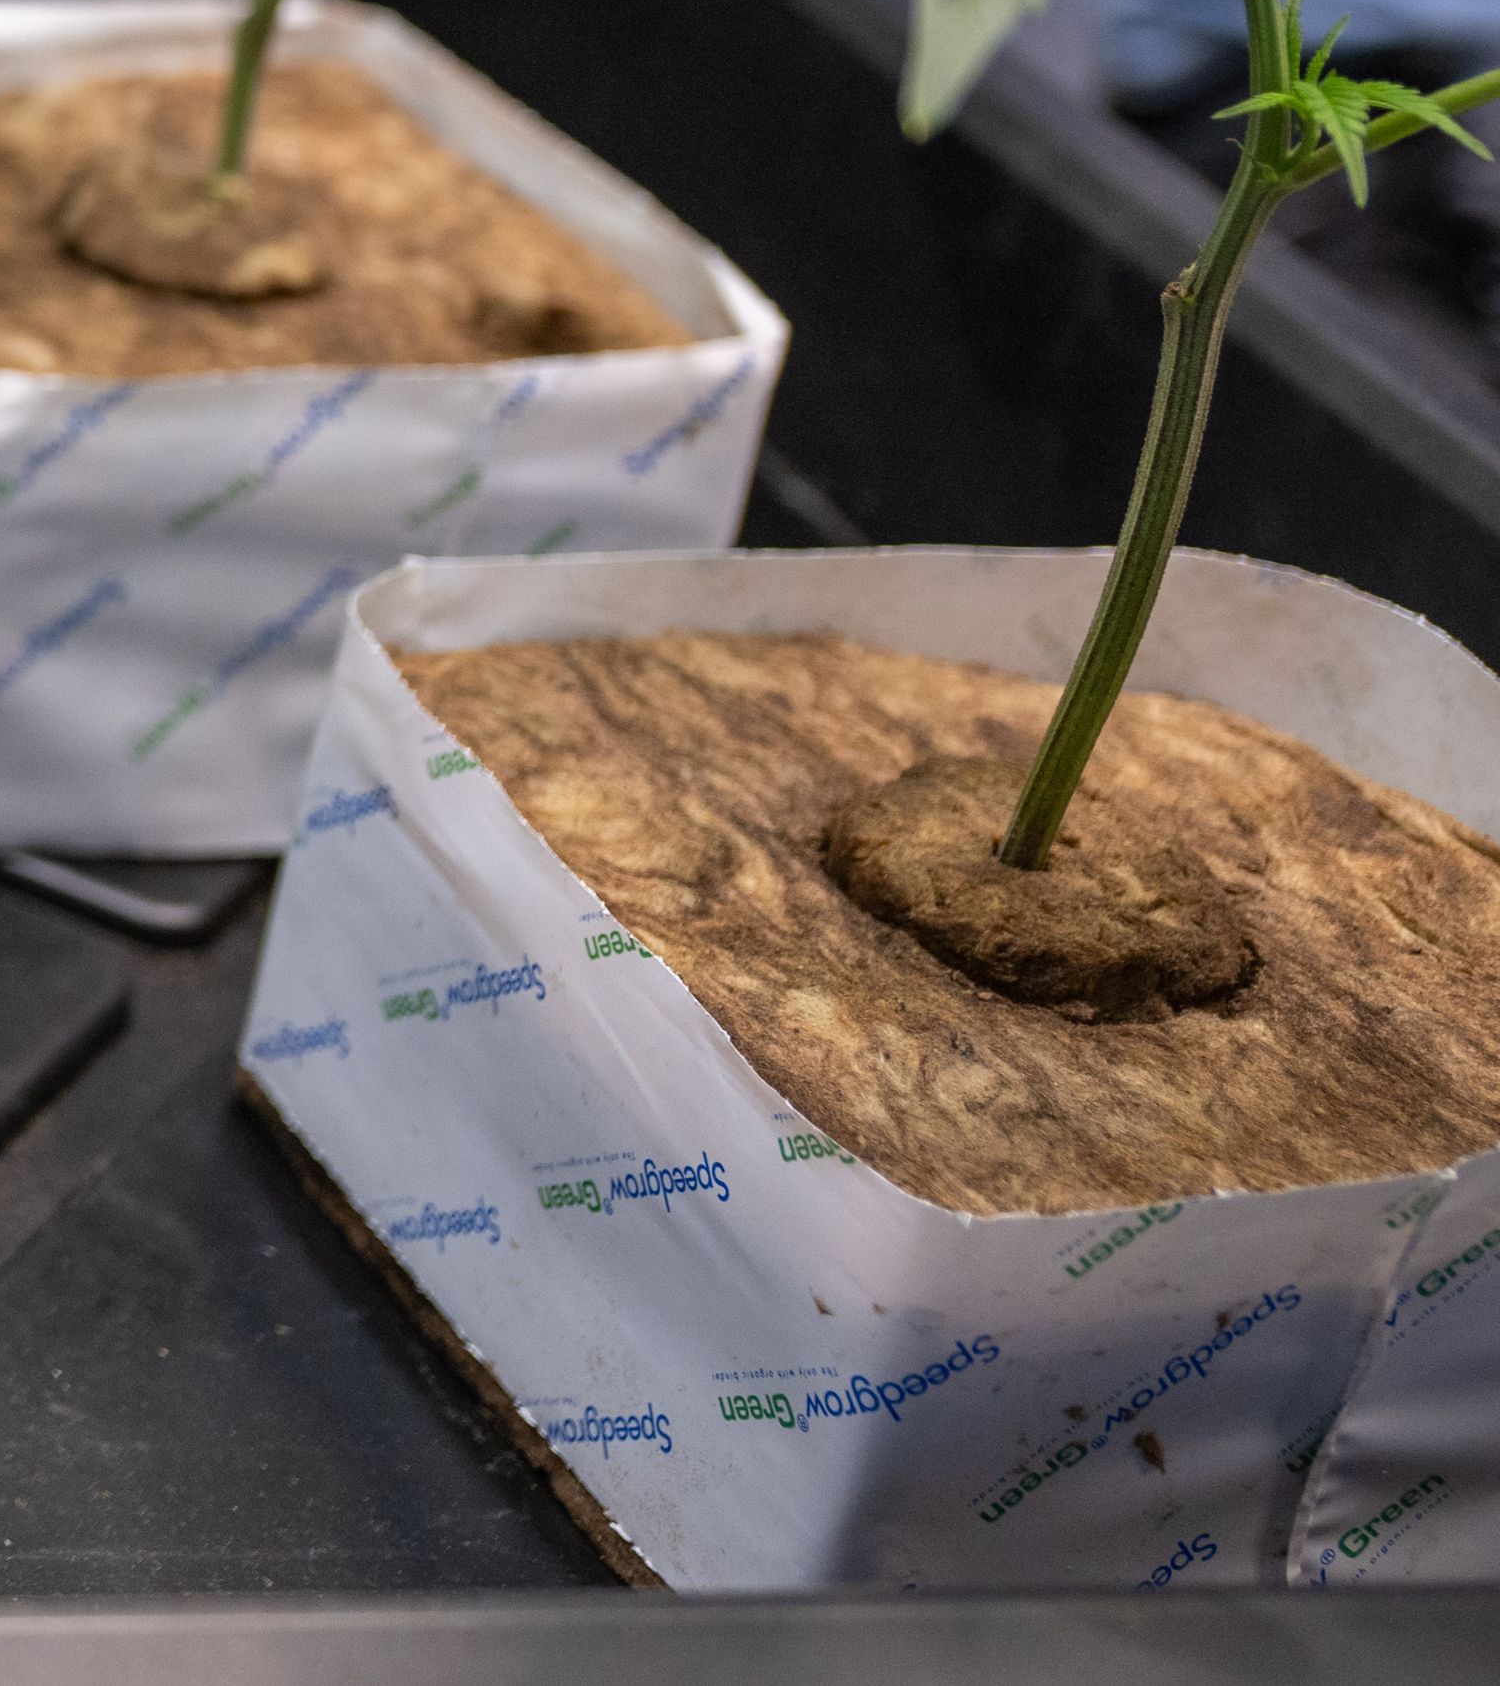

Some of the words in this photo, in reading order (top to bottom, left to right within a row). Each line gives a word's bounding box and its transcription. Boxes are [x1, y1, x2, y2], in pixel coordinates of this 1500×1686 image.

[536, 1177, 604, 1216] Green
[1415, 1228, 1500, 1299] Gree
[718, 1392, 798, 1430] Green
[980, 1440, 1091, 1527] Green
[1338, 1472, 1448, 1561] Green
